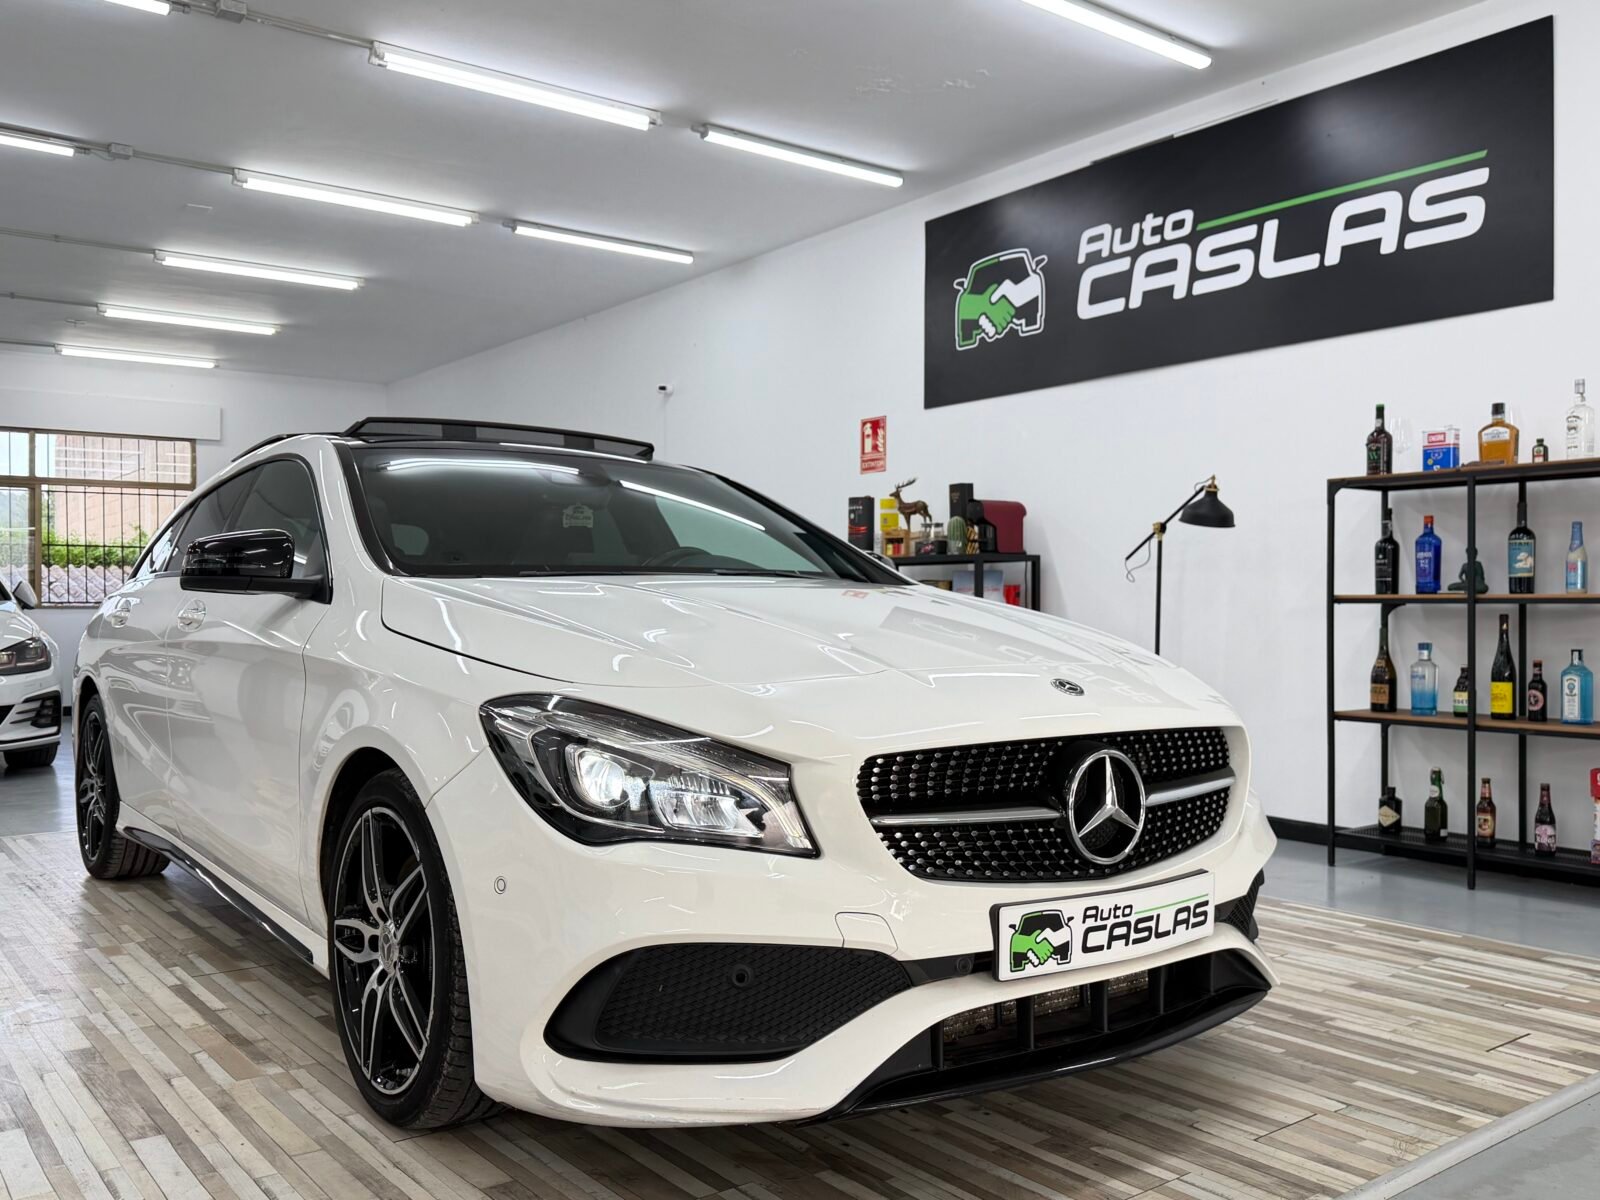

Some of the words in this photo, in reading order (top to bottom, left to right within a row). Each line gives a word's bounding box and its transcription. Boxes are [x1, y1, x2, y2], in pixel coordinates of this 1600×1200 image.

[1077, 209, 1194, 264] Auto
[1077, 167, 1490, 320] CASLAS
[1081, 904, 1133, 924] Auto
[1081, 900, 1210, 954] CASLAS
